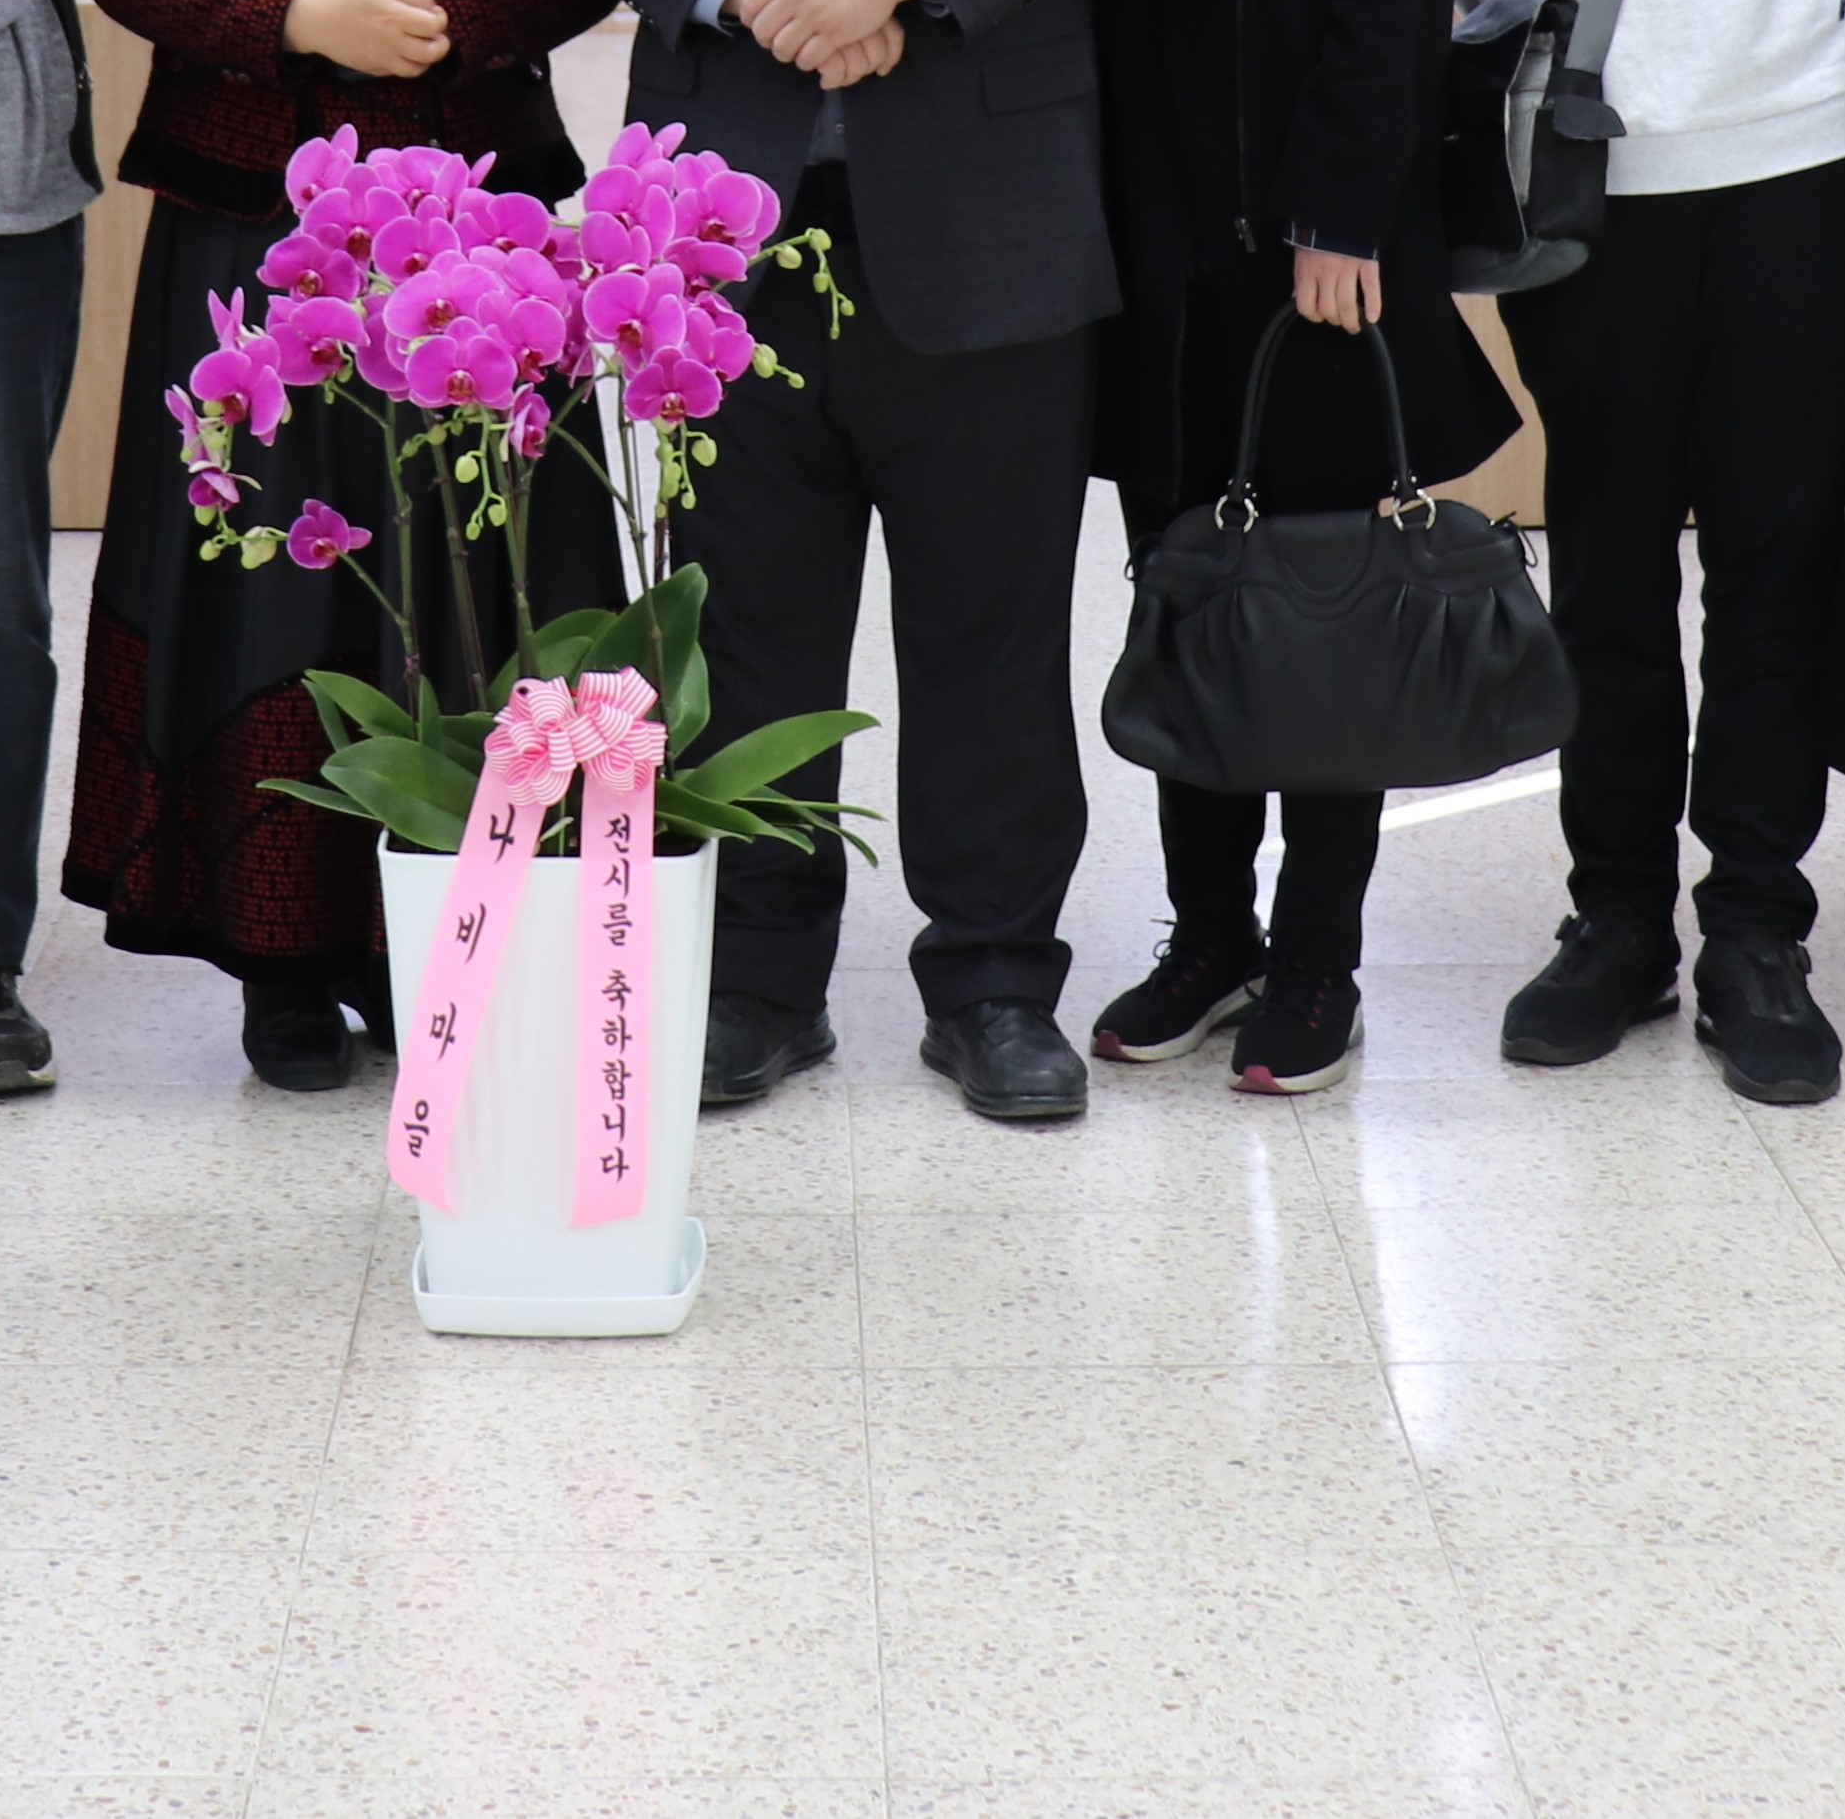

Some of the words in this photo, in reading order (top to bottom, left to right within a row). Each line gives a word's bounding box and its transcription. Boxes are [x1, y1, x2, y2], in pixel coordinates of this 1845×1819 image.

[403, 803, 517, 1158] 나비마을
[603, 813, 632, 947] 전시를
[600, 970, 633, 1183] 축하합니다
